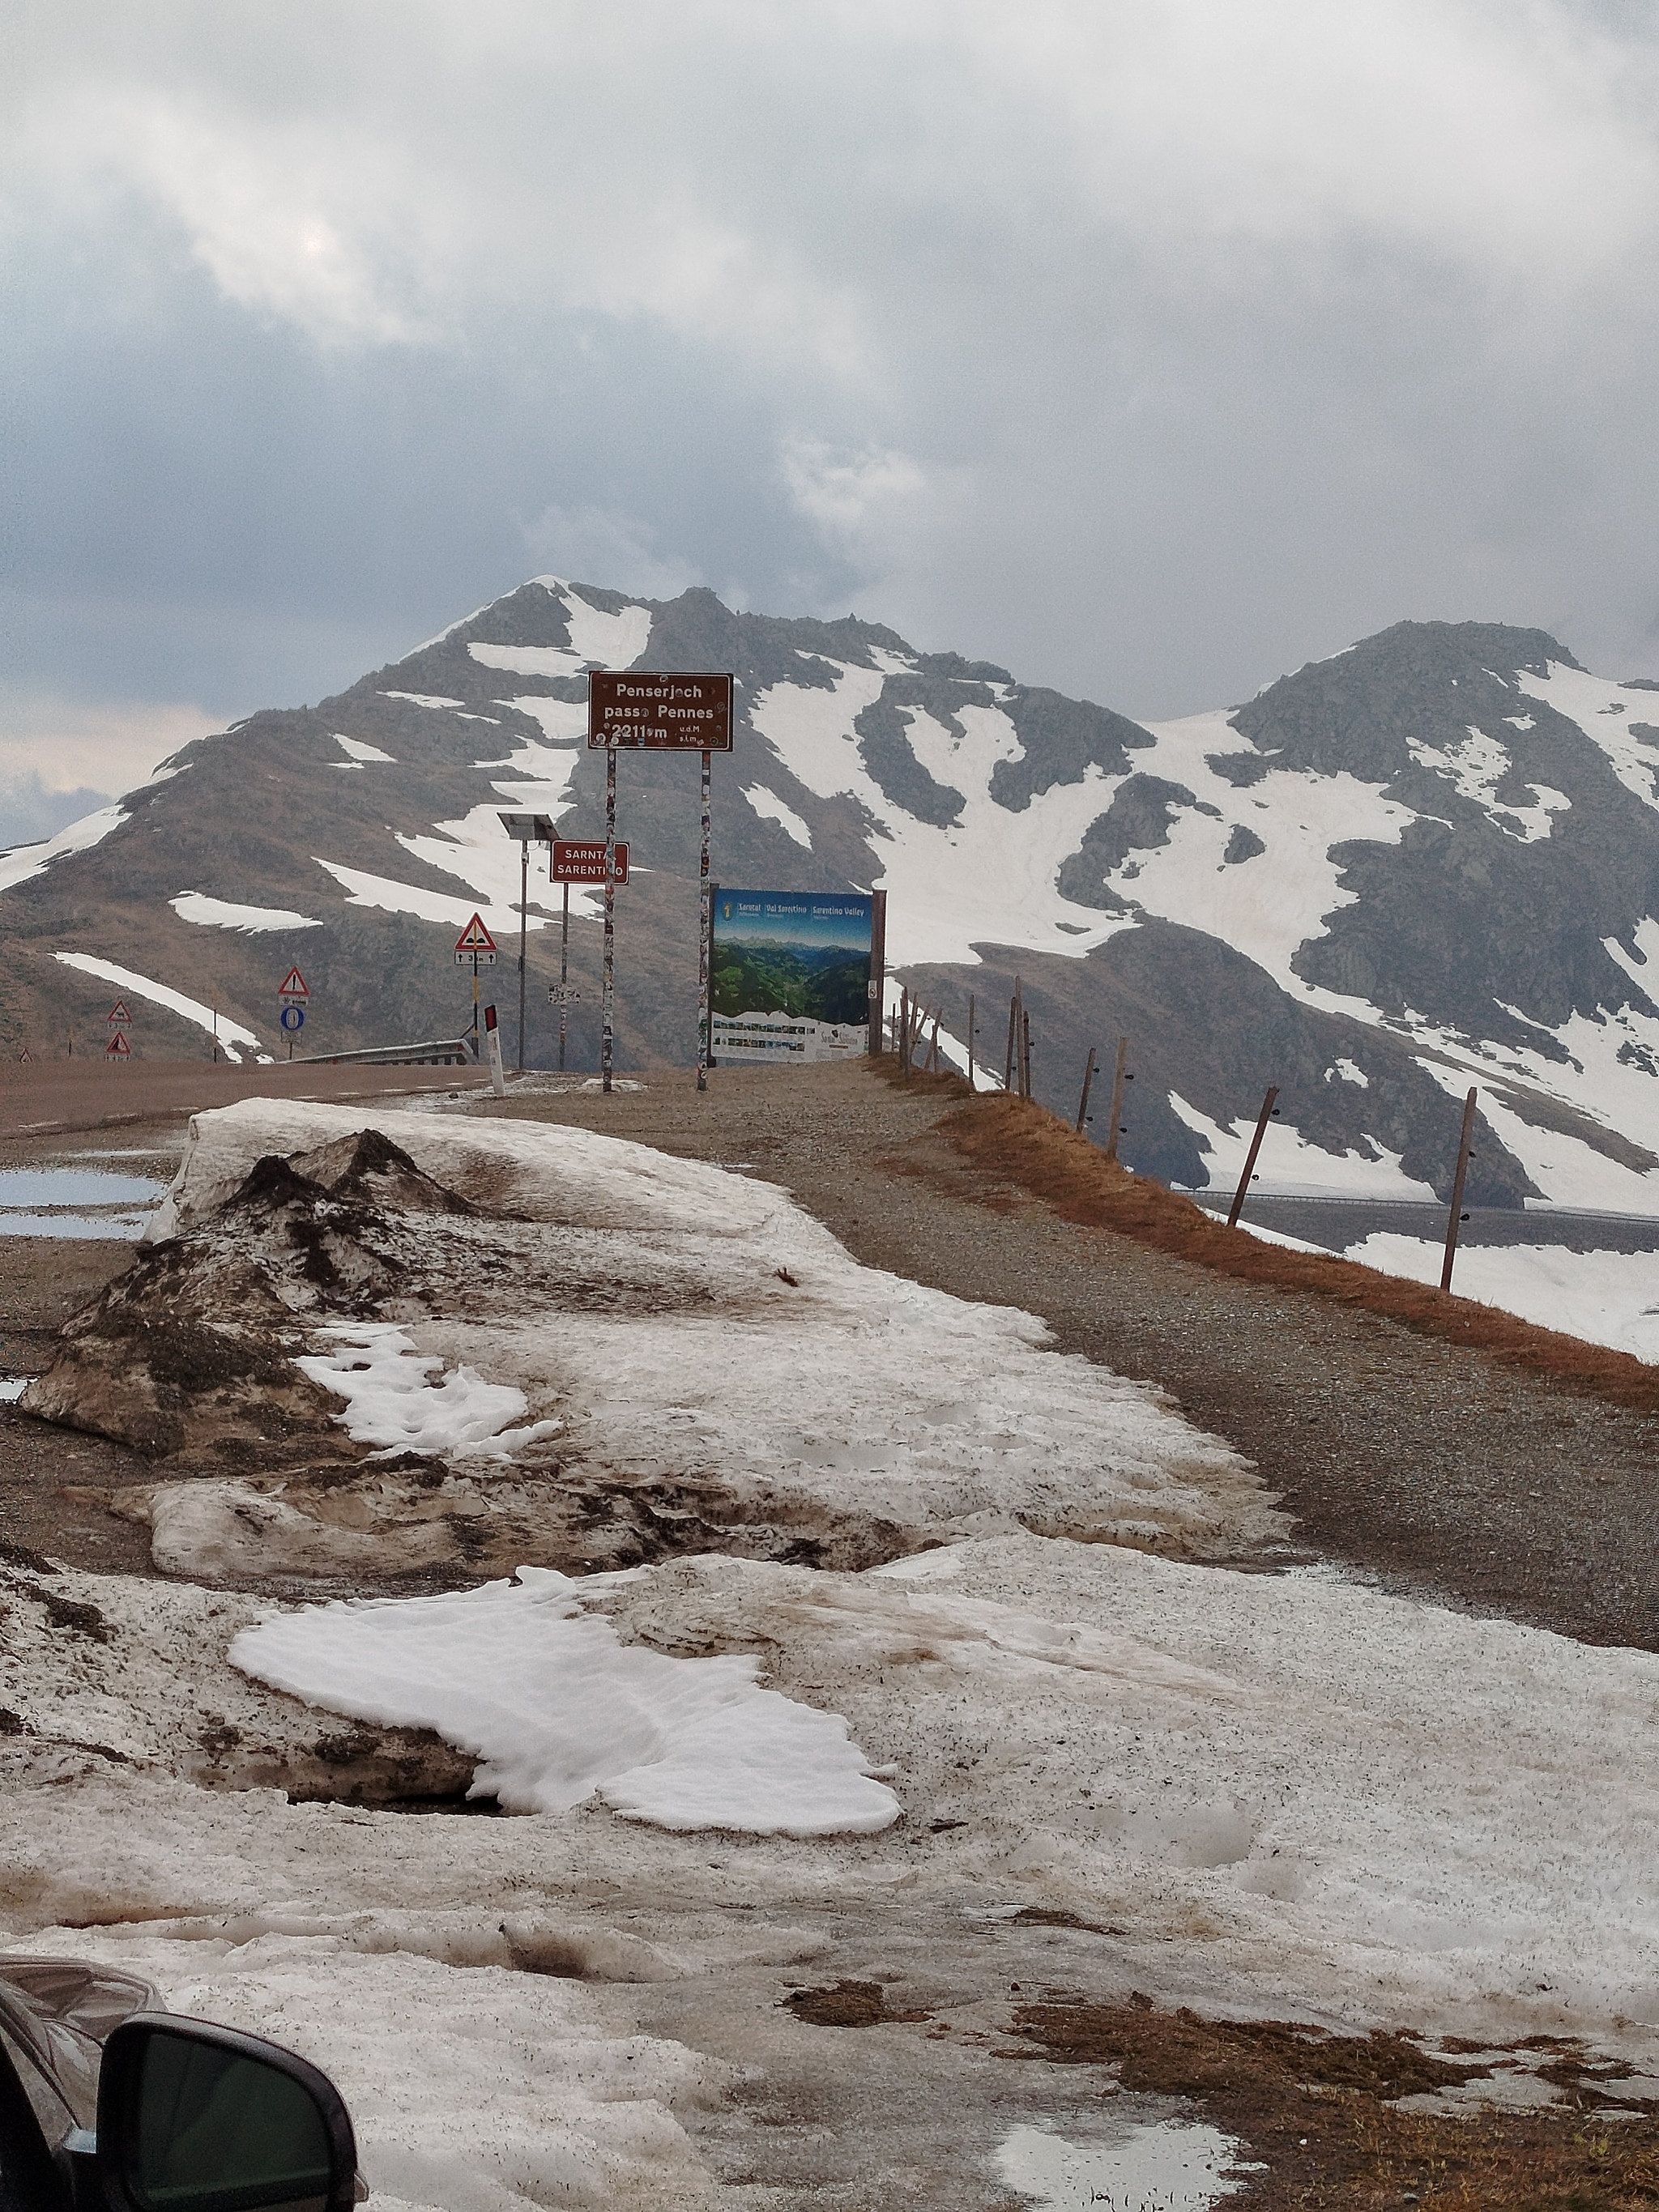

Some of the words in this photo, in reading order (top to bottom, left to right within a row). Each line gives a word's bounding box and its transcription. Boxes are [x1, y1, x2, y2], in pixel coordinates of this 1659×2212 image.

[658, 705, 714, 718] Pennes
[612, 724, 645, 738] 2211
[565, 849, 617, 860] SARNT
[557, 864, 623, 876] SARENTIO
[812, 906, 843, 915] Sarentino
[844, 907, 864, 917] Valley
